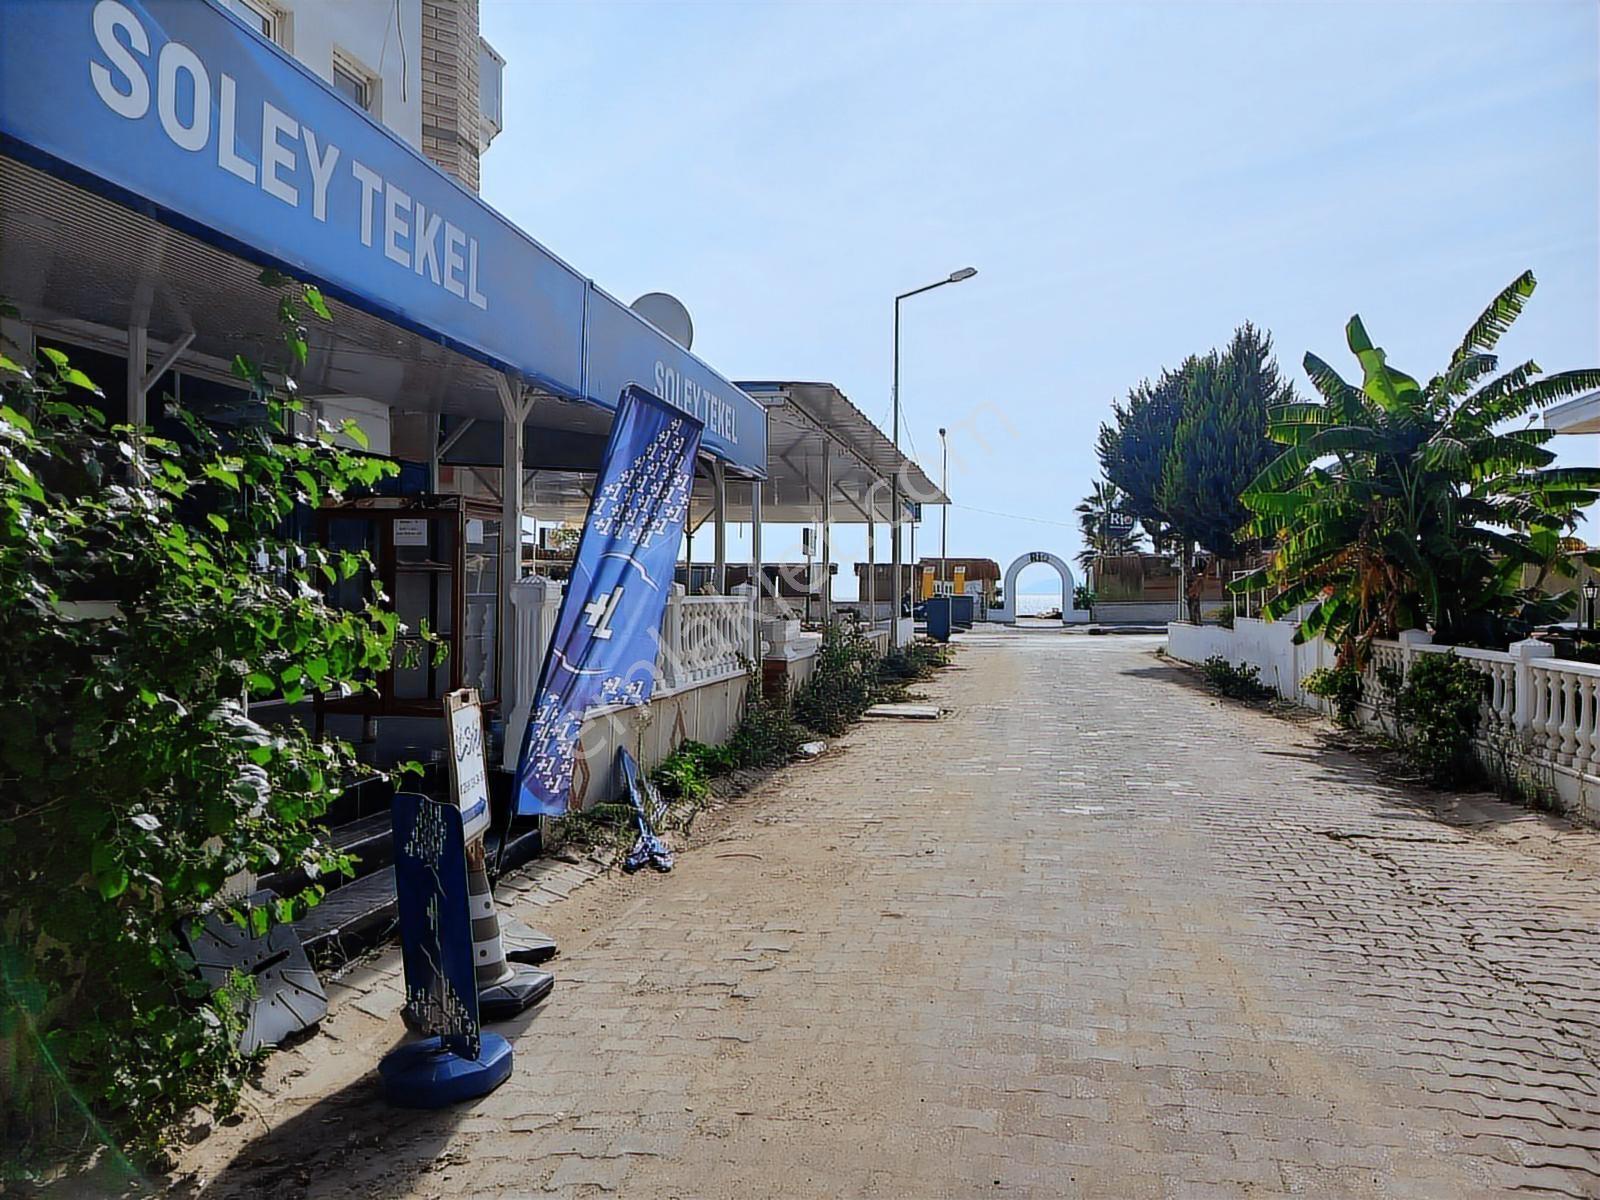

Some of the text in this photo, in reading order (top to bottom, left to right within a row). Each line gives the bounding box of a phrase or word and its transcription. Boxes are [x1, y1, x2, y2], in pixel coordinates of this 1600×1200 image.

[90, 0, 488, 311] SOLEY TEKEL
[654, 361, 738, 444] SOLEY TEKEL
[1110, 512, 1133, 525] Rio
[585, 585, 625, 640] +1
